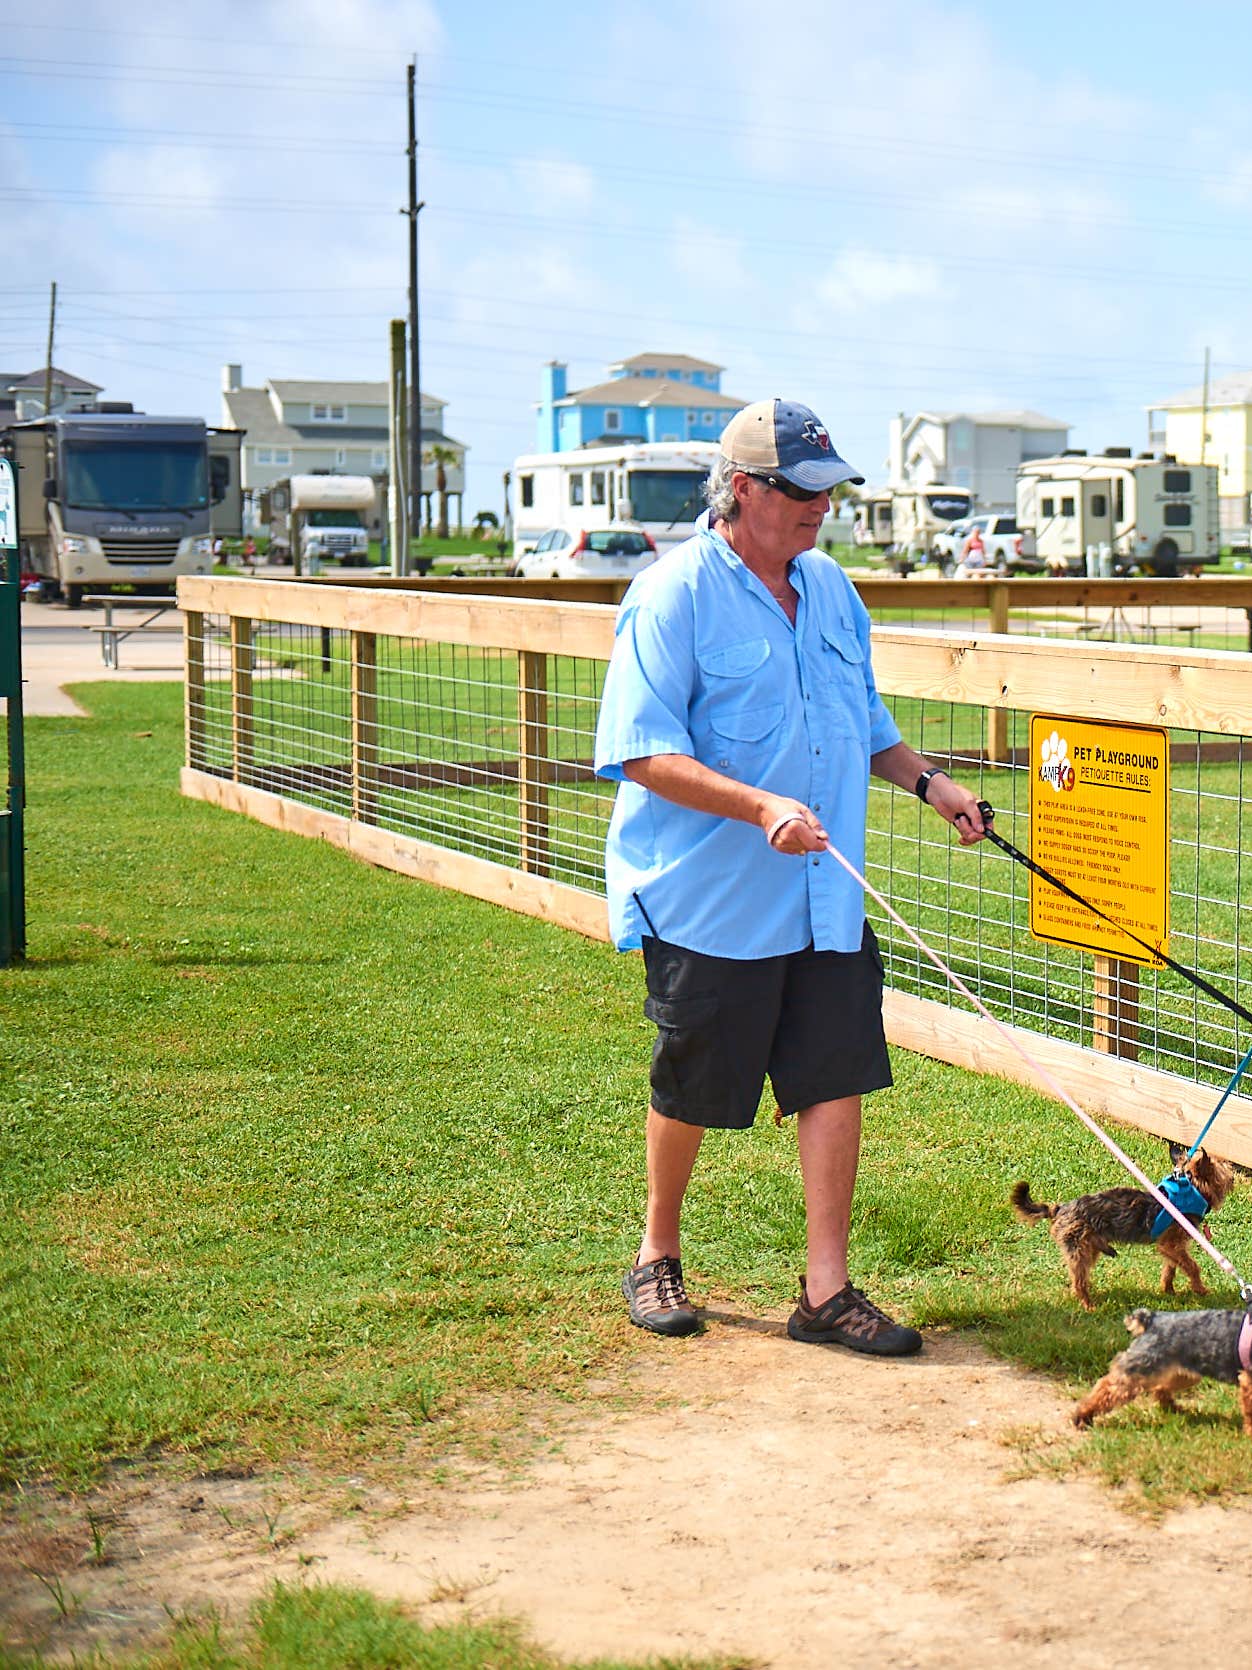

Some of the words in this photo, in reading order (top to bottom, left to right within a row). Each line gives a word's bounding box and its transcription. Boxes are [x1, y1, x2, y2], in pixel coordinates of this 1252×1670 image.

[1074, 747, 1092, 760] PET
[1096, 748, 1159, 769] PLAYGROUND
[1081, 767, 1123, 783] PETIQUETTE
[1126, 772, 1151, 787] RULES:
